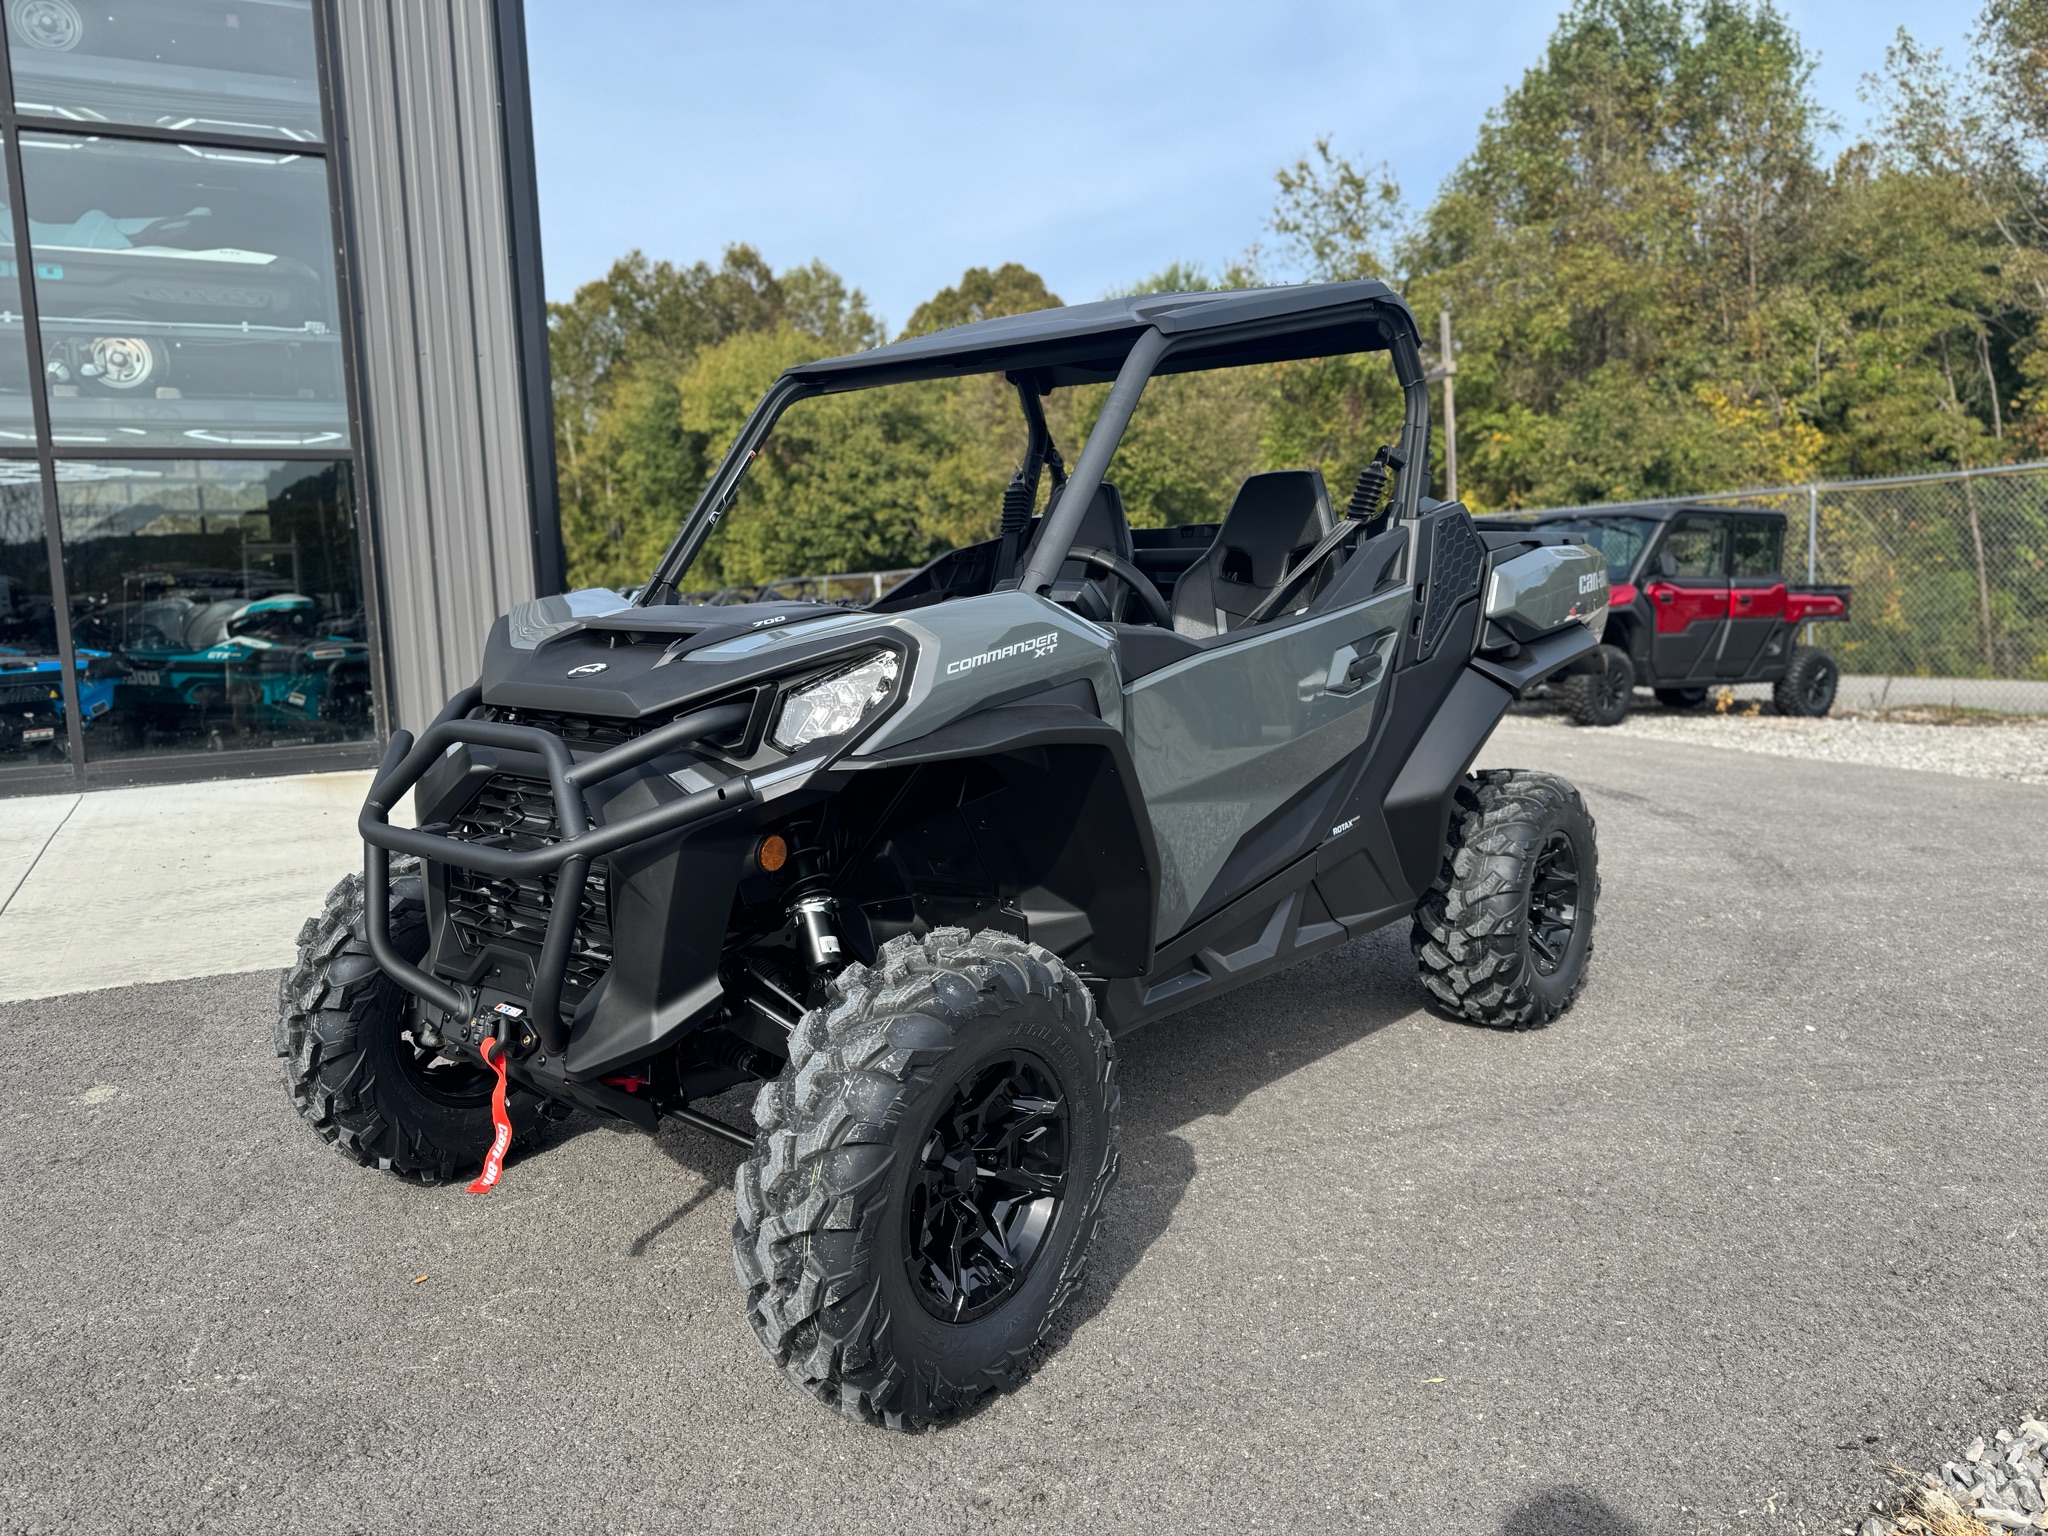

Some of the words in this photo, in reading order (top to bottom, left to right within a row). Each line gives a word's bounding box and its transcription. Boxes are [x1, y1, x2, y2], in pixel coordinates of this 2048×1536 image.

[752, 615, 786, 628] 700
[946, 631, 1058, 675] COMMANDER
[1033, 643, 1058, 659] XT
[1332, 820, 1354, 836] ROTAX
